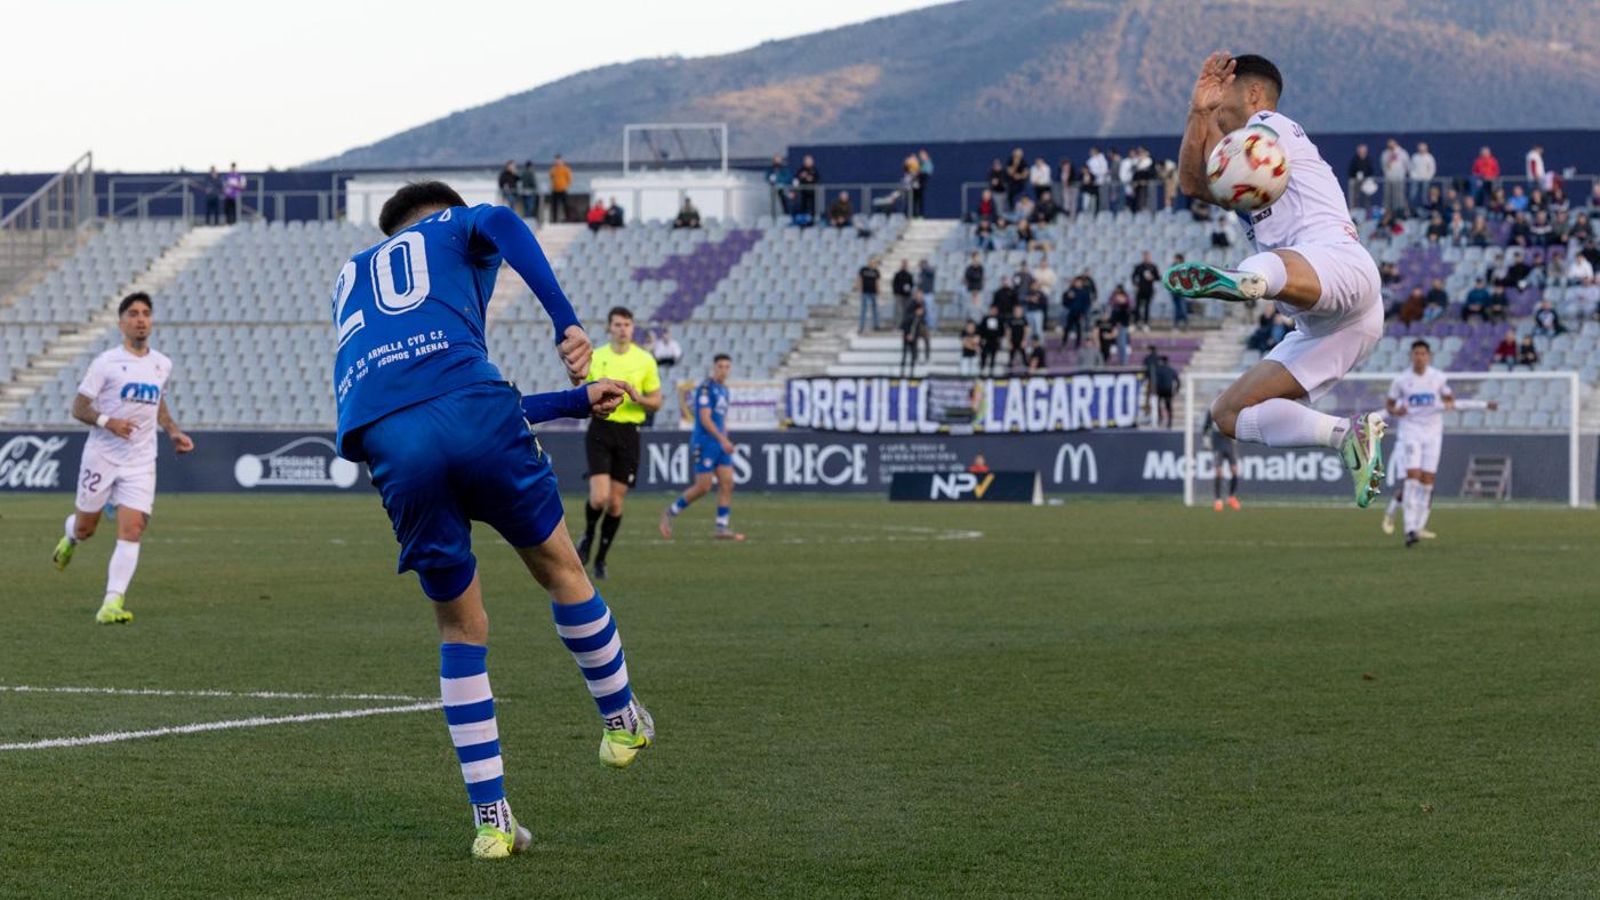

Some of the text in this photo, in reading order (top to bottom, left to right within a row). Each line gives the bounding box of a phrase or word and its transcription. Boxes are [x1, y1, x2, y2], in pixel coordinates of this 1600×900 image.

[332, 231, 430, 350] 20
[368, 341, 403, 361] ARMILLA
[415, 341, 449, 357] ARENAS
[984, 374, 1137, 433] LAGARTO
[82, 468, 101, 492] 22
[762, 443, 868, 485] TRECE
